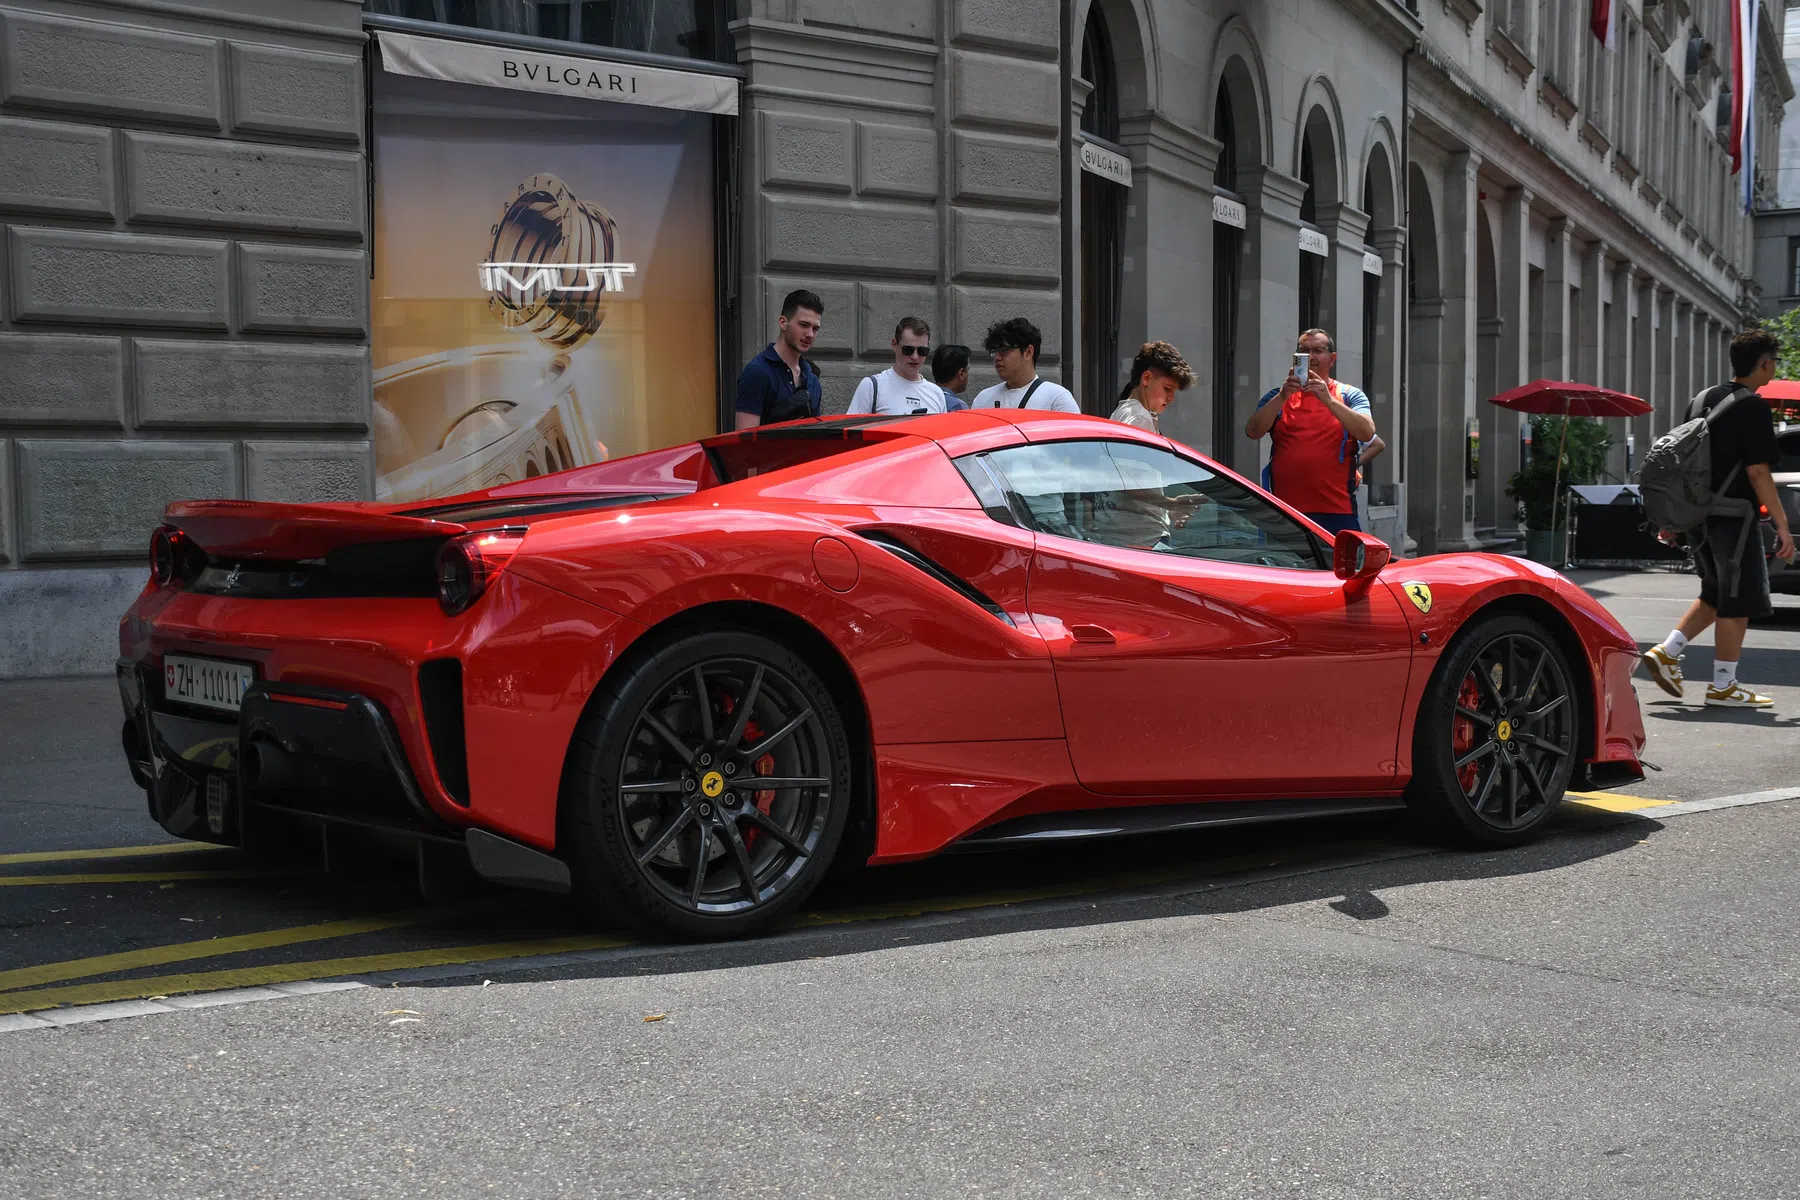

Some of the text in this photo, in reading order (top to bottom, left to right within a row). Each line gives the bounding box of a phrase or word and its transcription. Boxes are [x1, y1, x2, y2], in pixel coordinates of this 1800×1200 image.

[502, 60, 637, 94] BVLGARI
[1085, 150, 1123, 176] BVLGARI
[1213, 201, 1240, 221] VLGARI
